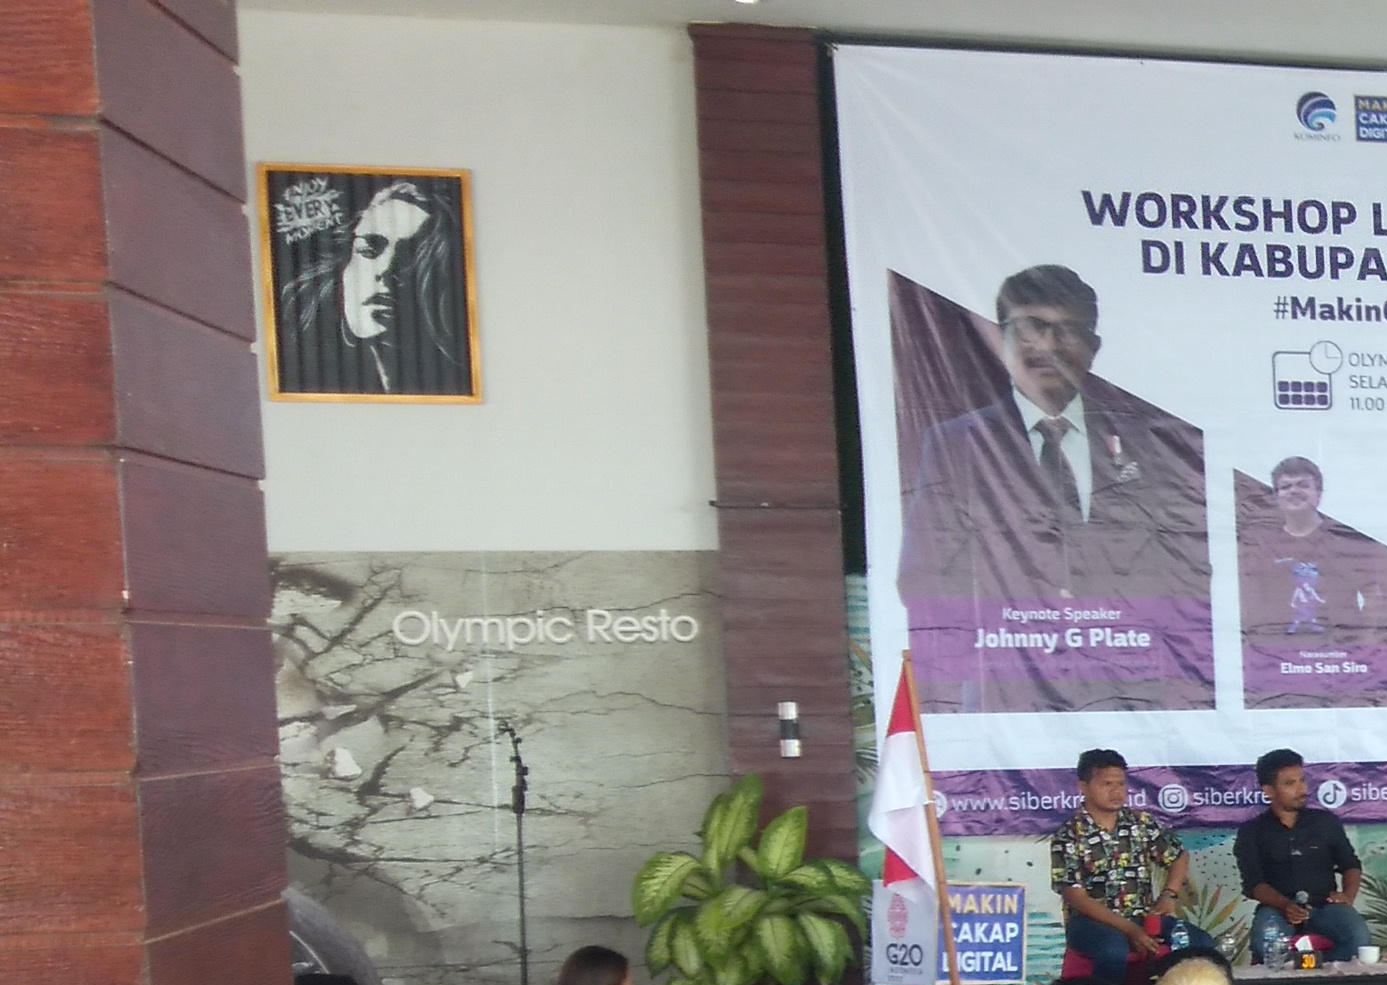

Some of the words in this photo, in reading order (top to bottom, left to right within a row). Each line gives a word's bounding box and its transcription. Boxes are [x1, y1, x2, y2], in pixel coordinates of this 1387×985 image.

[1294, 132, 1341, 142] KOMINFO
[1080, 190, 1358, 236] WORKSHOP
[1140, 239, 1186, 276] DI
[1350, 397, 1385, 411] 11.00
[1002, 607, 1061, 624] Keynote
[1063, 607, 1122, 624] Speaker
[392, 610, 574, 651] Olympic
[586, 609, 699, 644] Resto
[974, 628, 1059, 654] Johnny
[1064, 629, 1083, 648] G
[1090, 627, 1151, 648] Plate
[1280, 662, 1312, 675] Elmo
[1315, 662, 1340, 675] San
[1342, 661, 1368, 674] Siro
[886, 943, 923, 966] G20
[1302, 954, 1315, 969] 30
